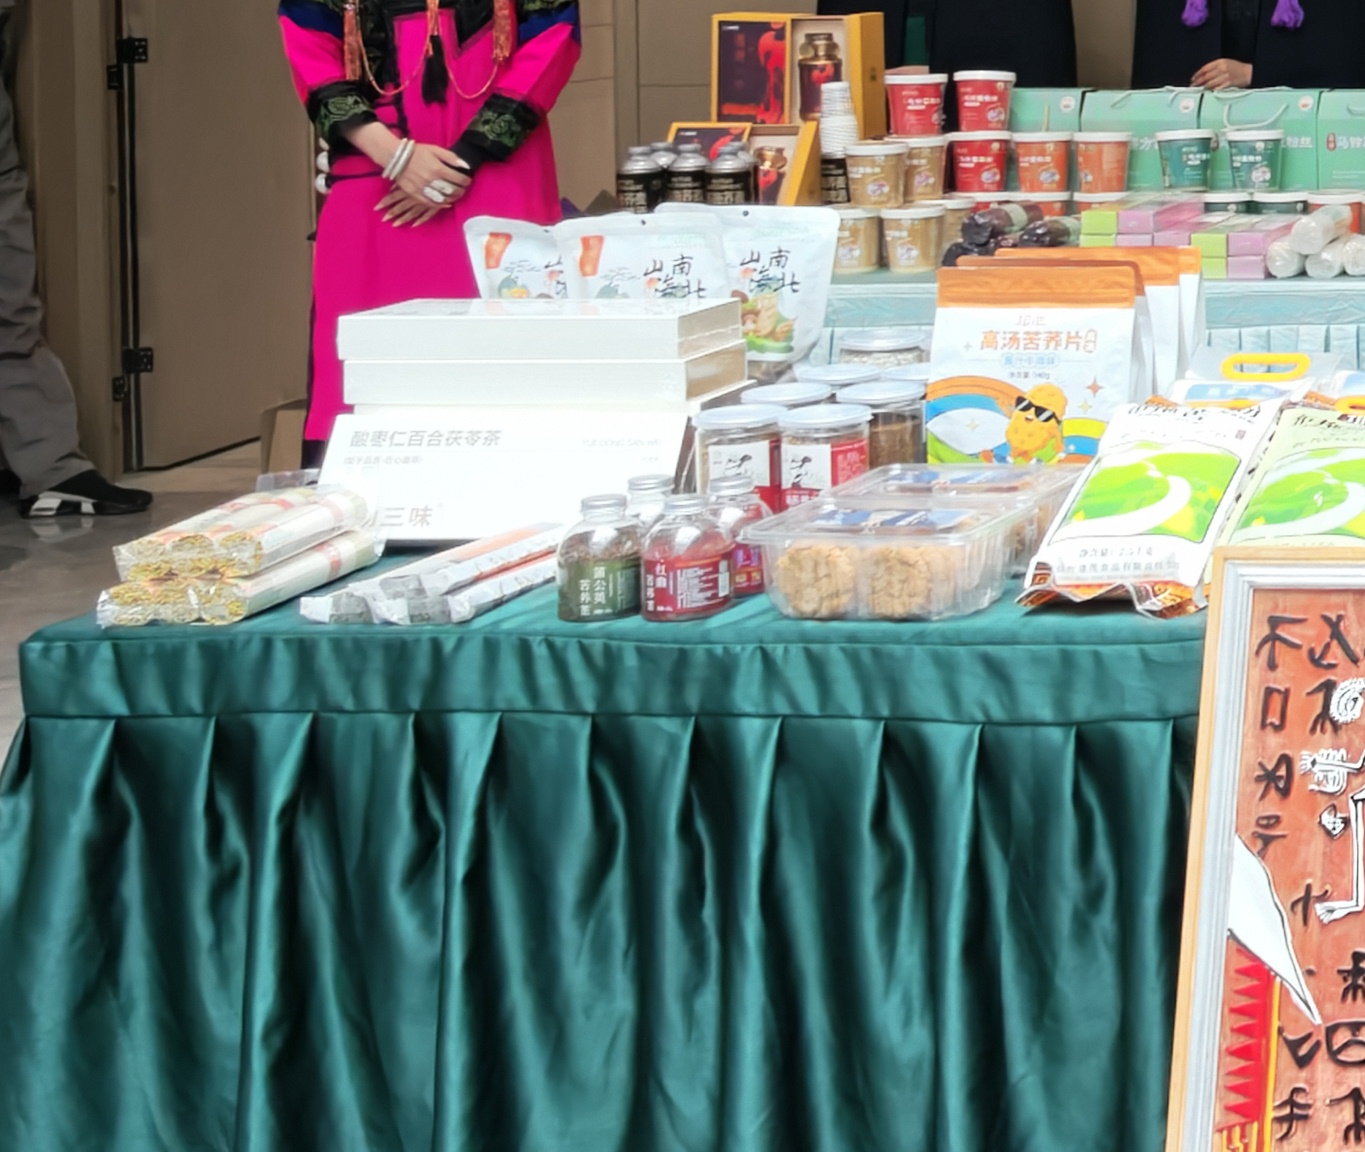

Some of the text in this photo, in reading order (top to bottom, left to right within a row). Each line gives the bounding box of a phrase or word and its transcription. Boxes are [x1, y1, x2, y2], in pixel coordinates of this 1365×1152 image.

[980, 330, 1082, 351] 高汤苦荞片
